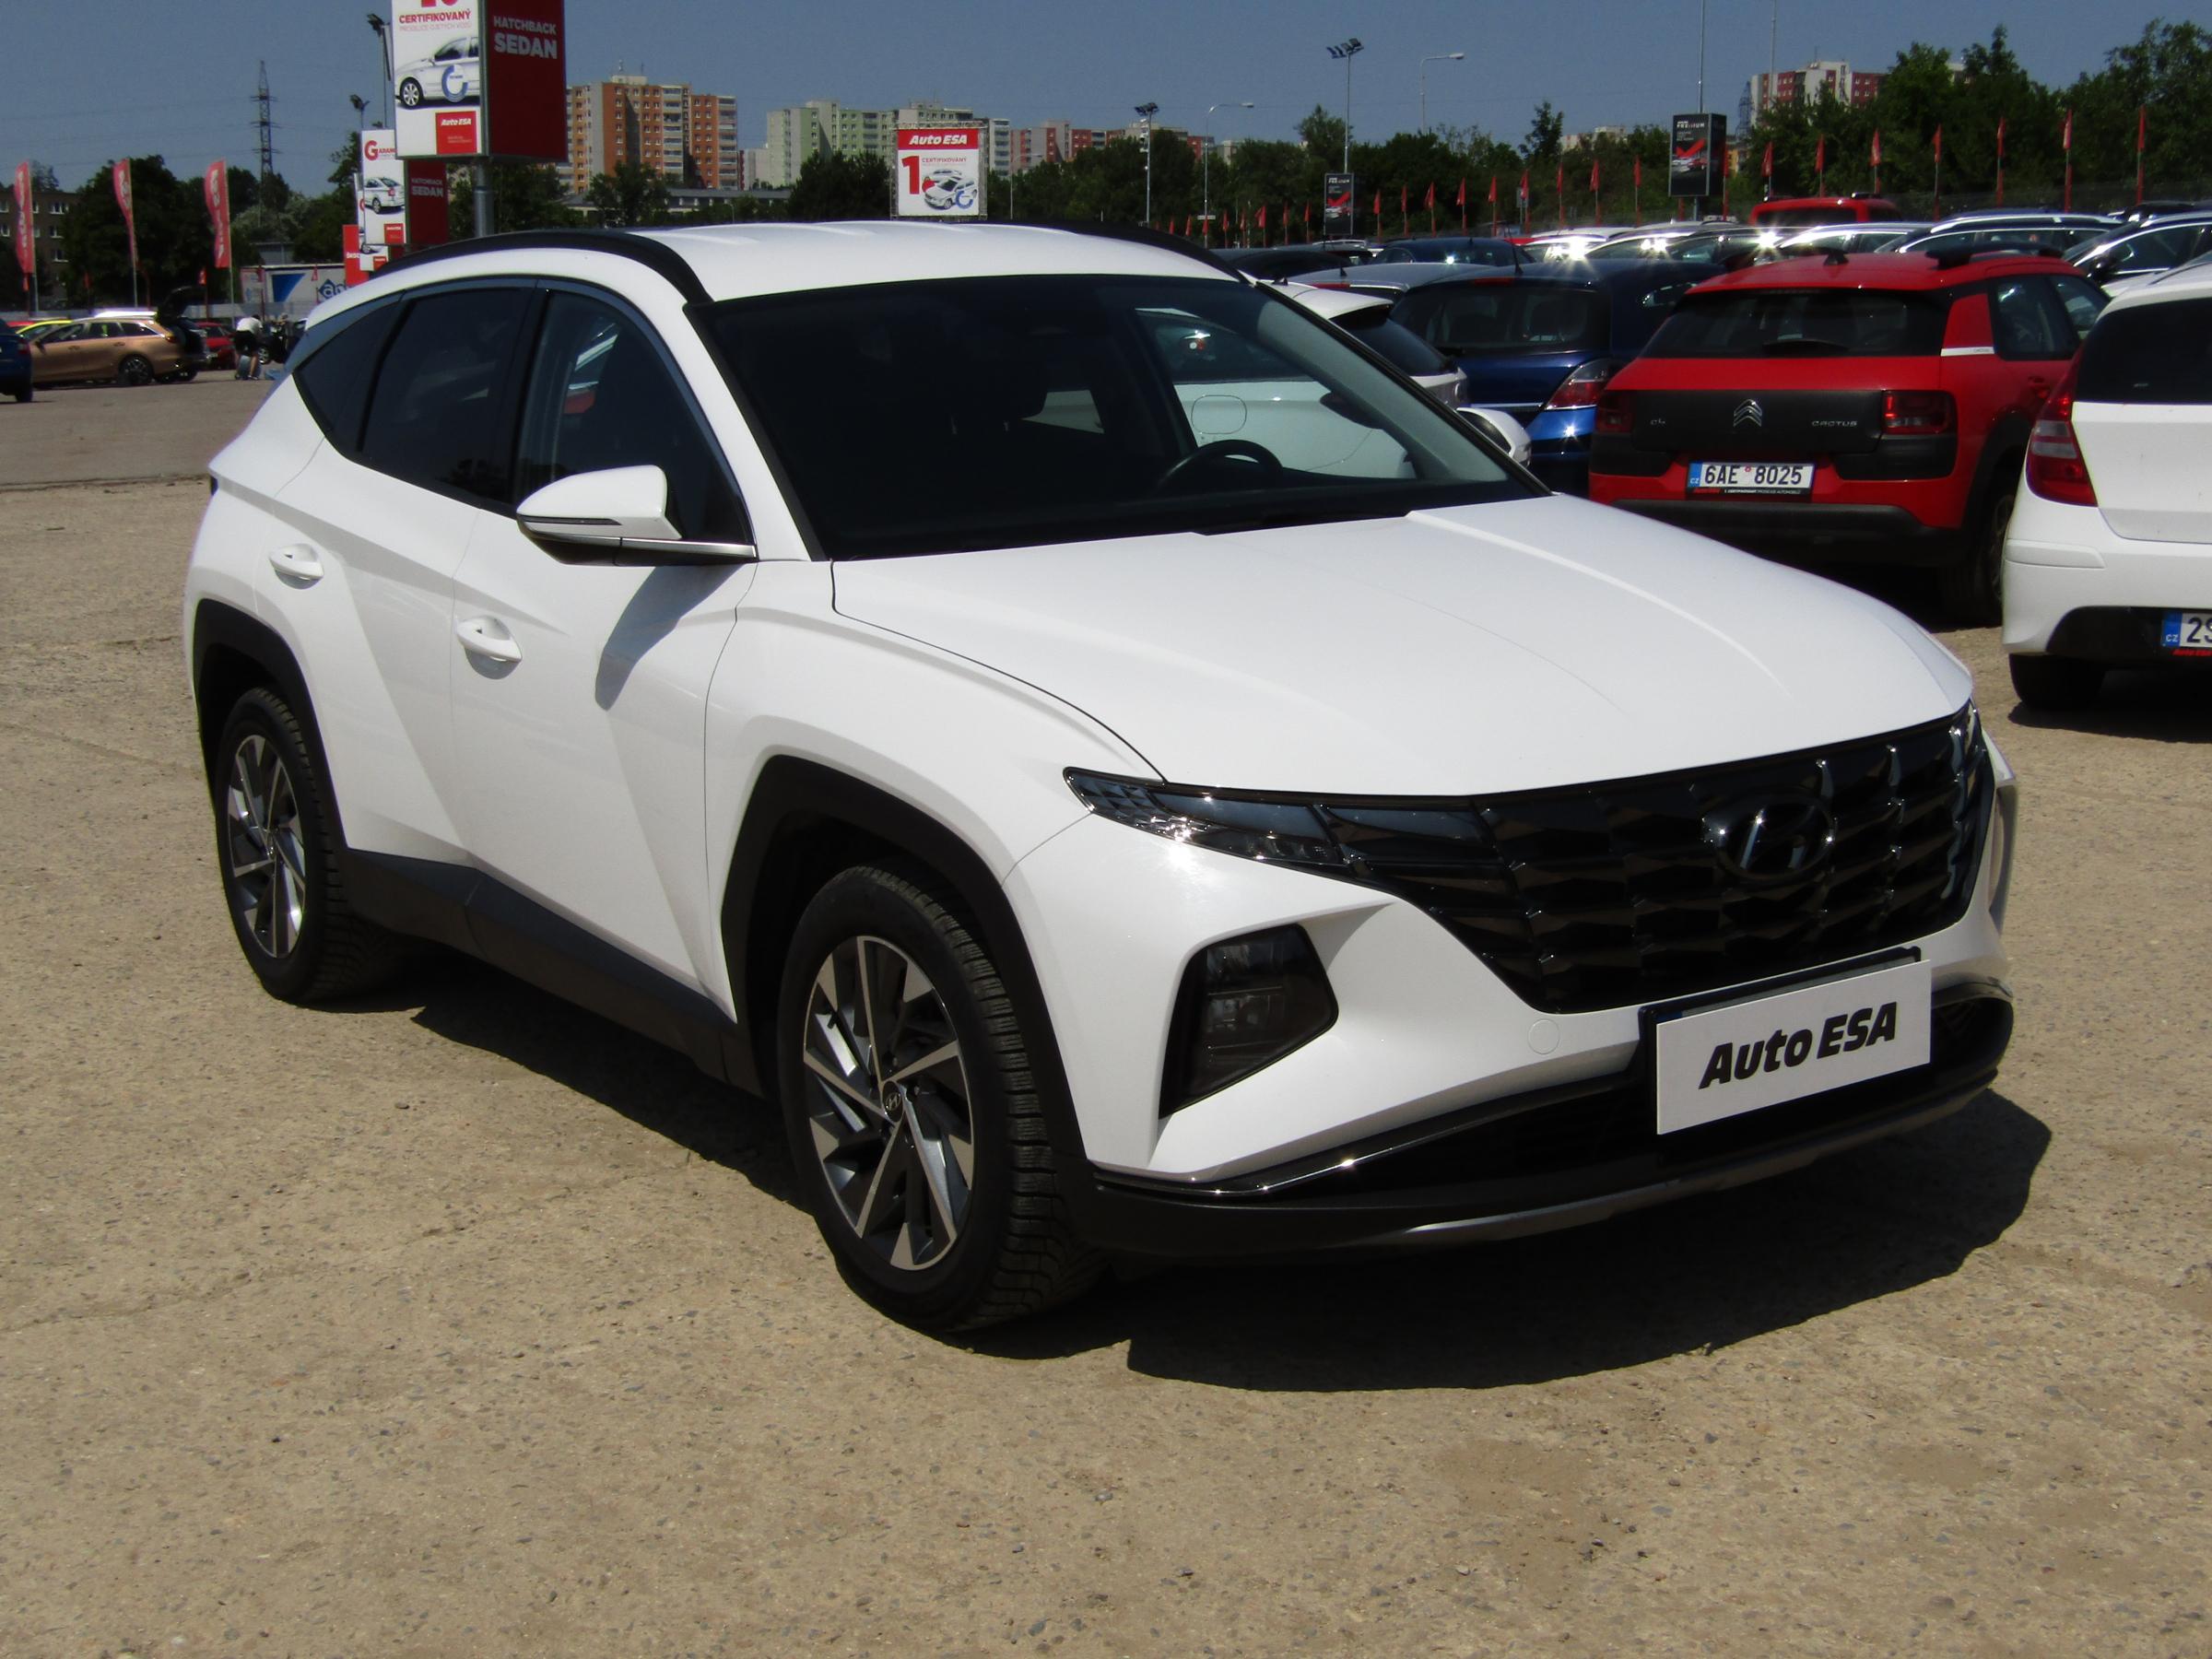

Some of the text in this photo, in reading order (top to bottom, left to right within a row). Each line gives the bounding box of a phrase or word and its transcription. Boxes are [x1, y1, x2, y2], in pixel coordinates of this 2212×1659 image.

[399, 8, 471, 24] CERTIFIKOVANÝ
[493, 16, 557, 35] HATCHBACK
[494, 32, 558, 60] SEDAN
[909, 135, 968, 145] Auto ESA
[901, 156, 920, 194] 1
[412, 186, 443, 197] SEDAN
[1704, 465, 1740, 485] 6AE
[1754, 465, 1803, 486] 8025
[2166, 634, 2179, 642] CZ
[1699, 1001, 1898, 1089] Auto ESA
